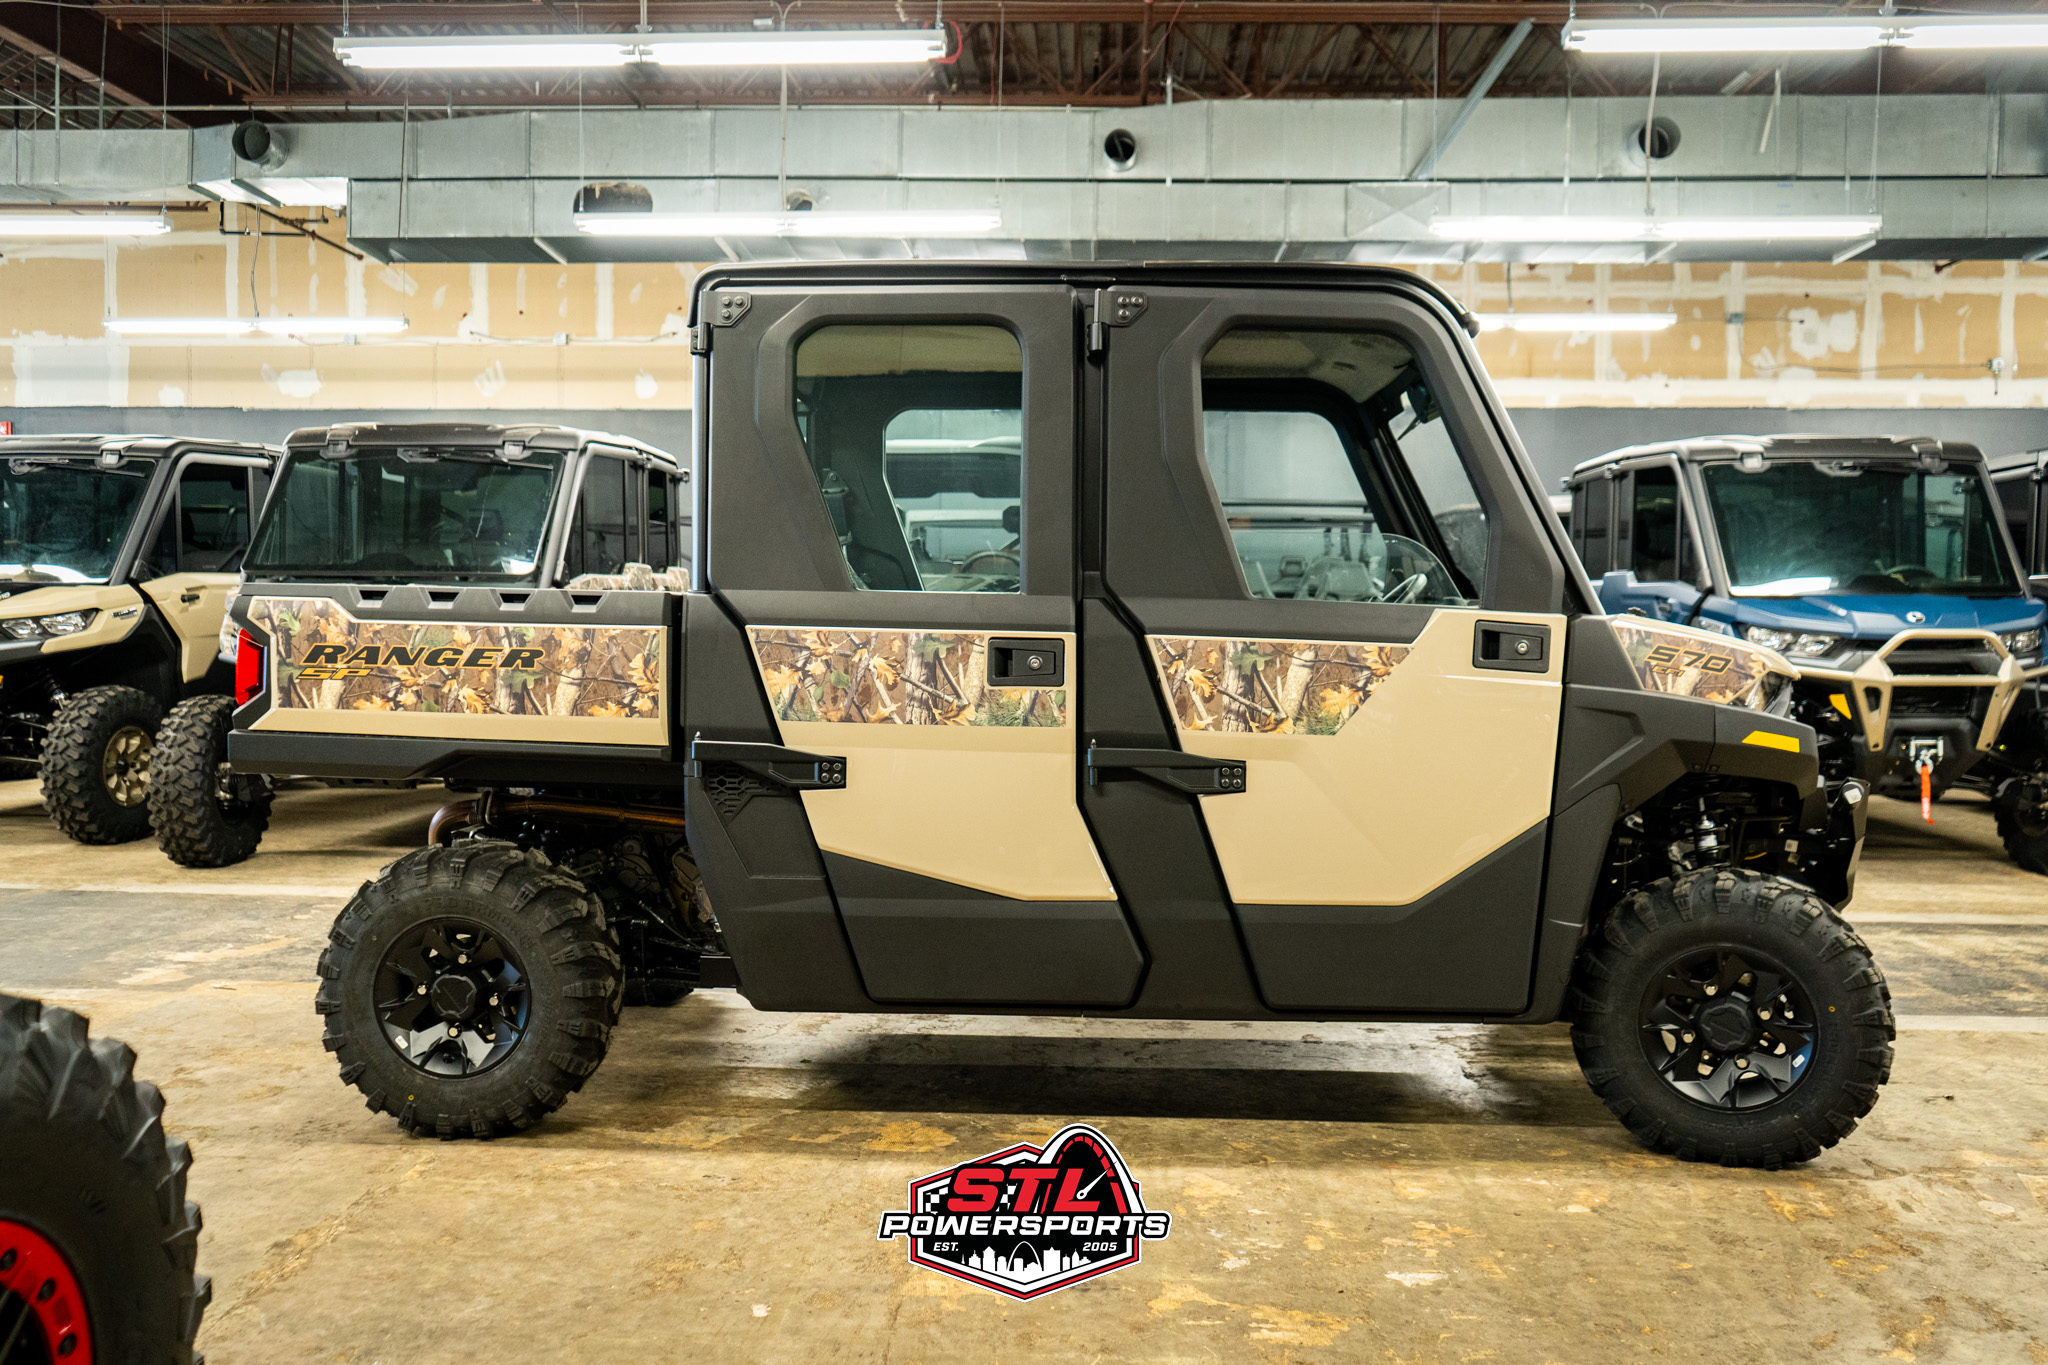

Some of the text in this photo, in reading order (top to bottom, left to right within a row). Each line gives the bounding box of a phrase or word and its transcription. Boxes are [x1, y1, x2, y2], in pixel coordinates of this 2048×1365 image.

[301, 643, 546, 669] RANGER
[1644, 644, 1734, 675] 570
[297, 667, 375, 680] SP
